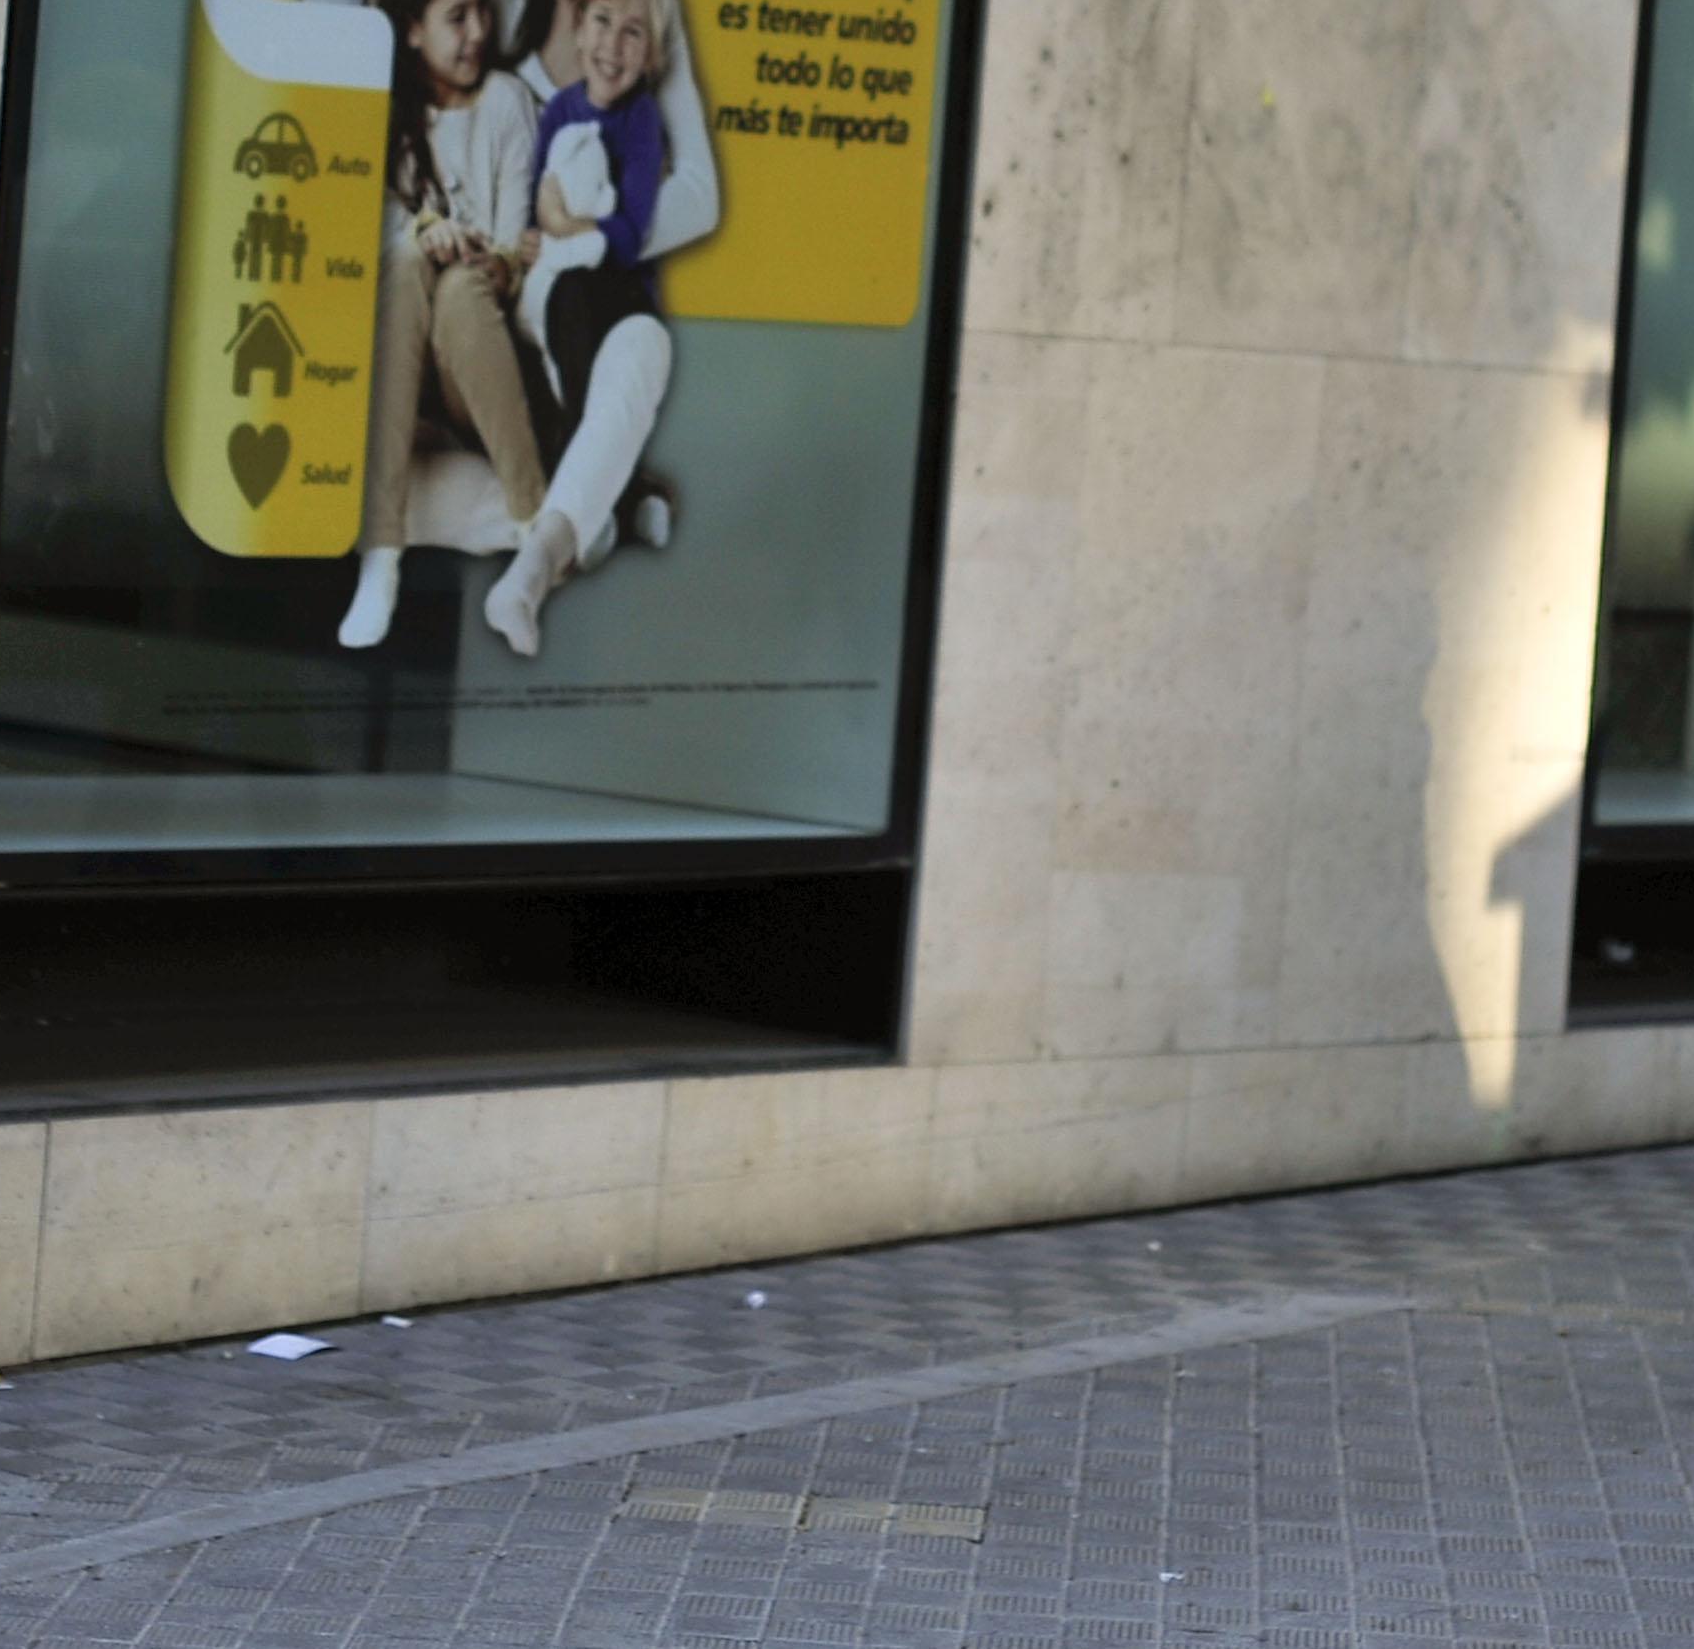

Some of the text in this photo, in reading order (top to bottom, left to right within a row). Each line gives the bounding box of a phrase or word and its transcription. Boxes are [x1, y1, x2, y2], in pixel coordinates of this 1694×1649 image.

[718, 1, 917, 46] es tener unido
[756, 52, 913, 102] todo lo que
[716, 98, 910, 150] más te importa
[326, 154, 372, 177] Auto
[325, 256, 365, 281] Vida
[304, 359, 358, 386] Hogar
[300, 462, 353, 486] Salud
